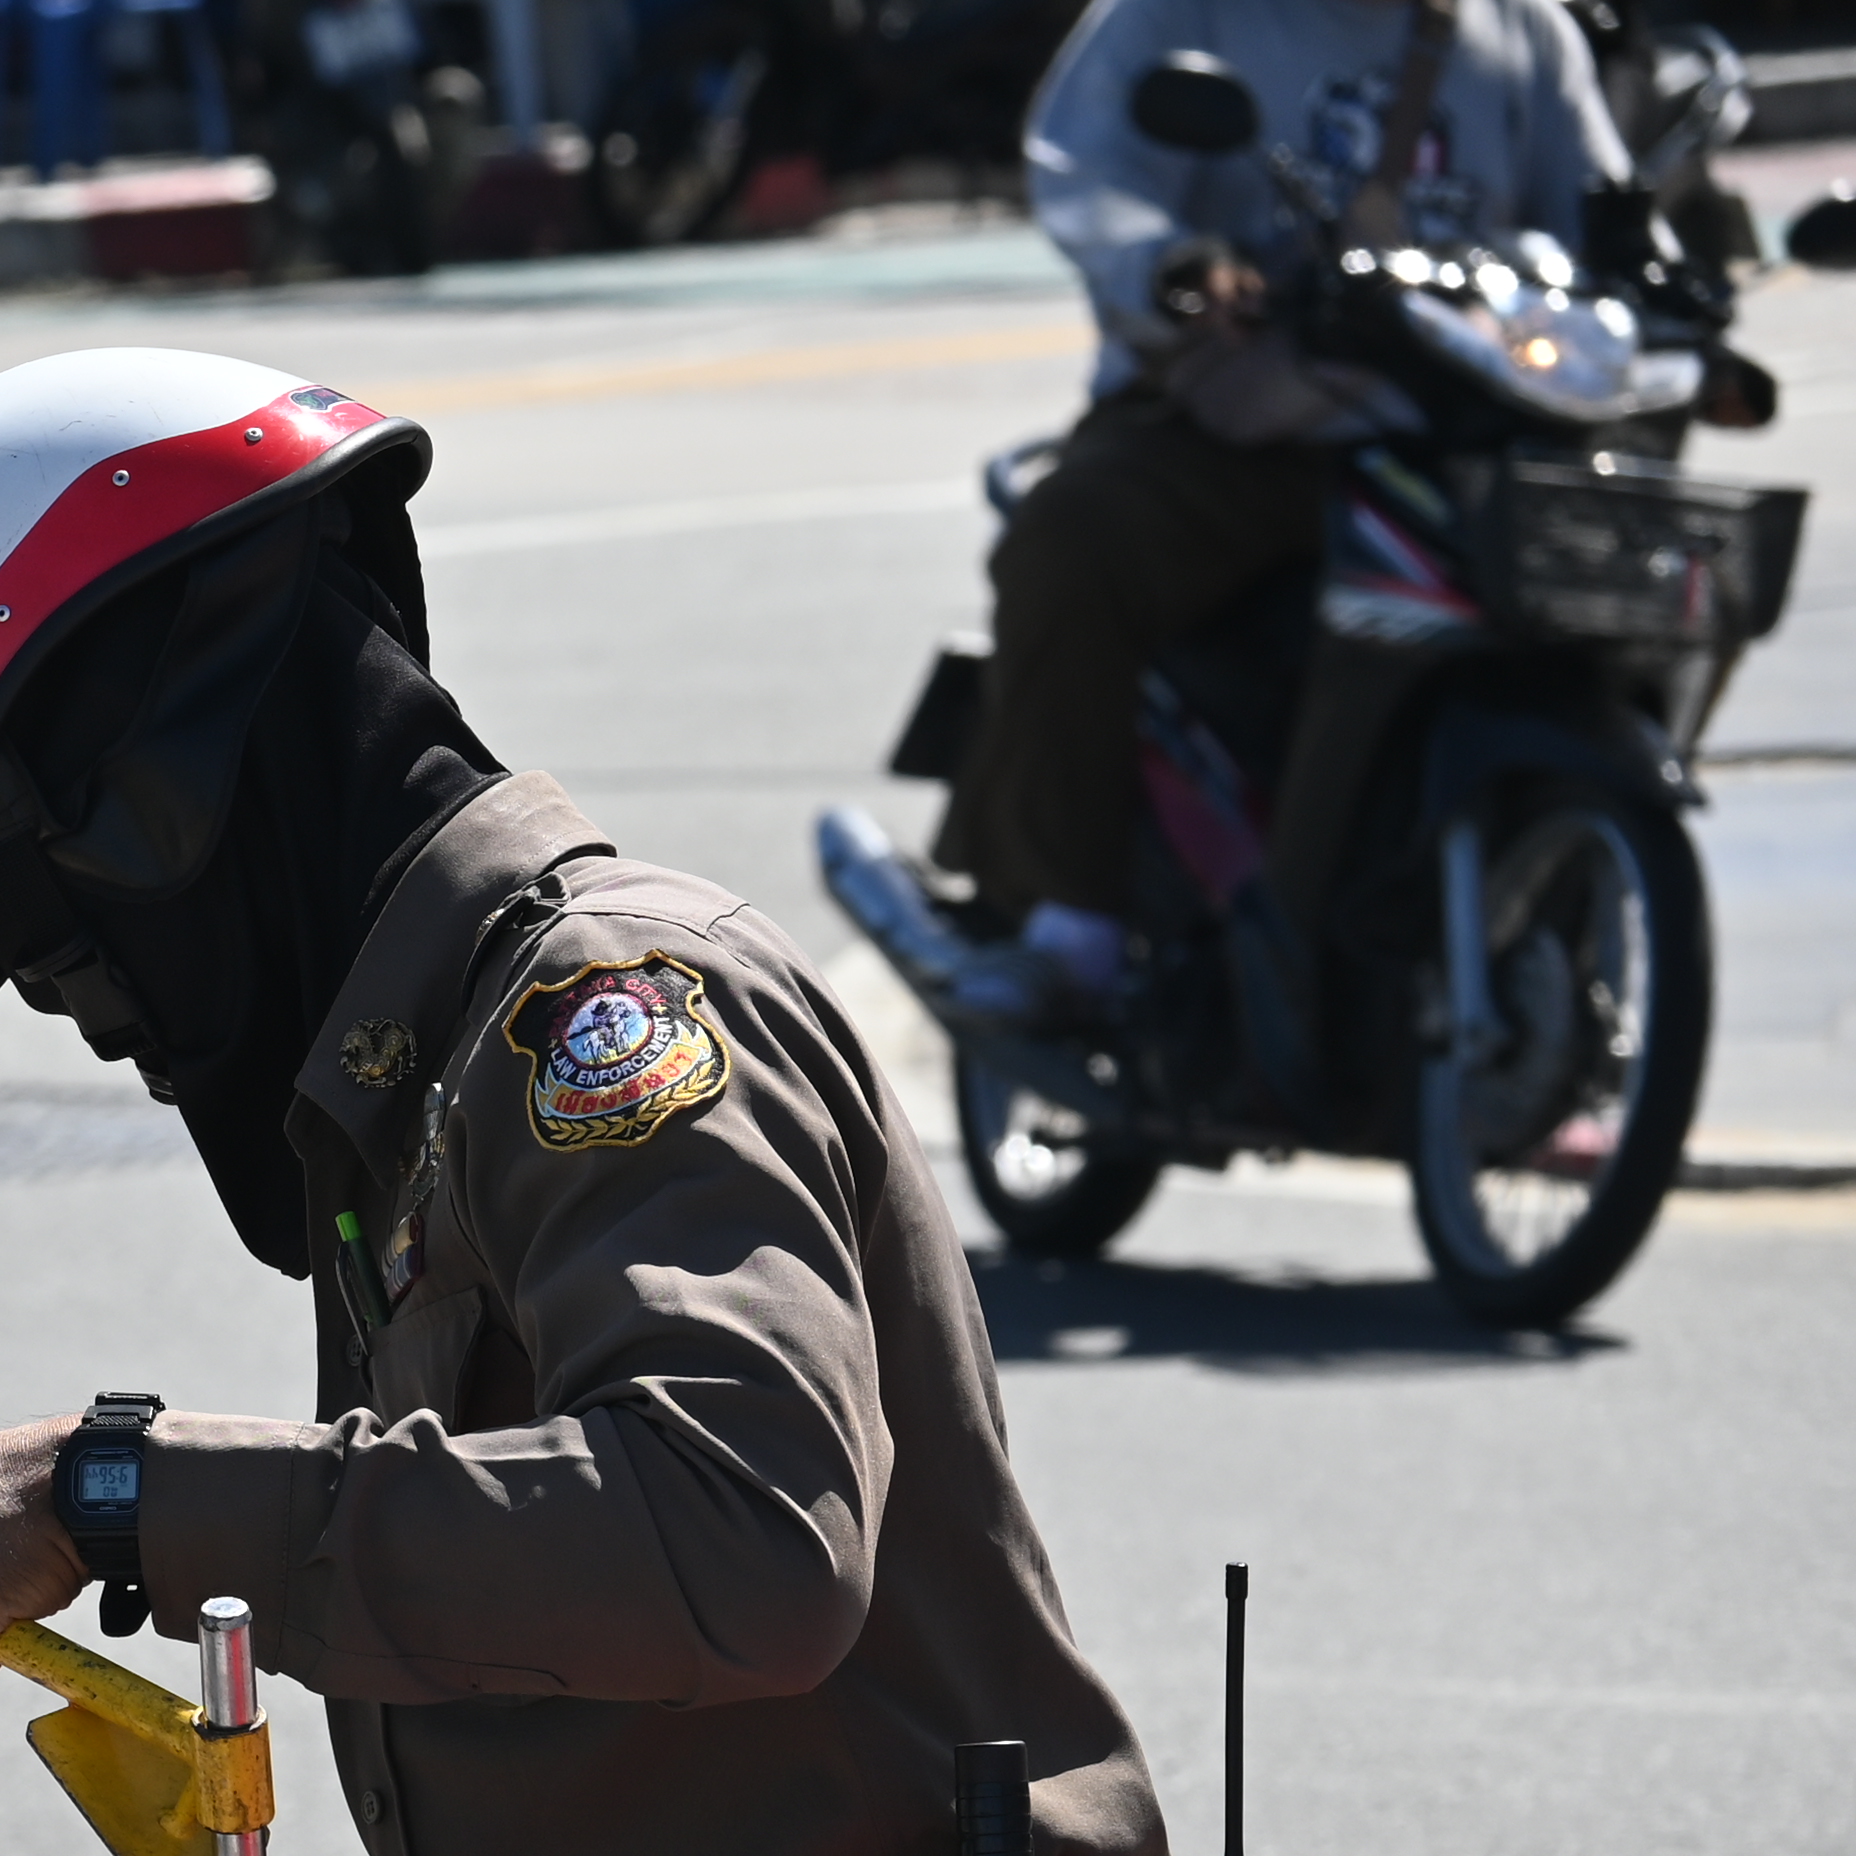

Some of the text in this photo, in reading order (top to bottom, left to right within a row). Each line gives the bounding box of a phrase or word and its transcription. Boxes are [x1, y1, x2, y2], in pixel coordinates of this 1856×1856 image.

[626, 978, 667, 1004] CITY
[550, 1014, 675, 1087] LAW ENFORCEMENT
